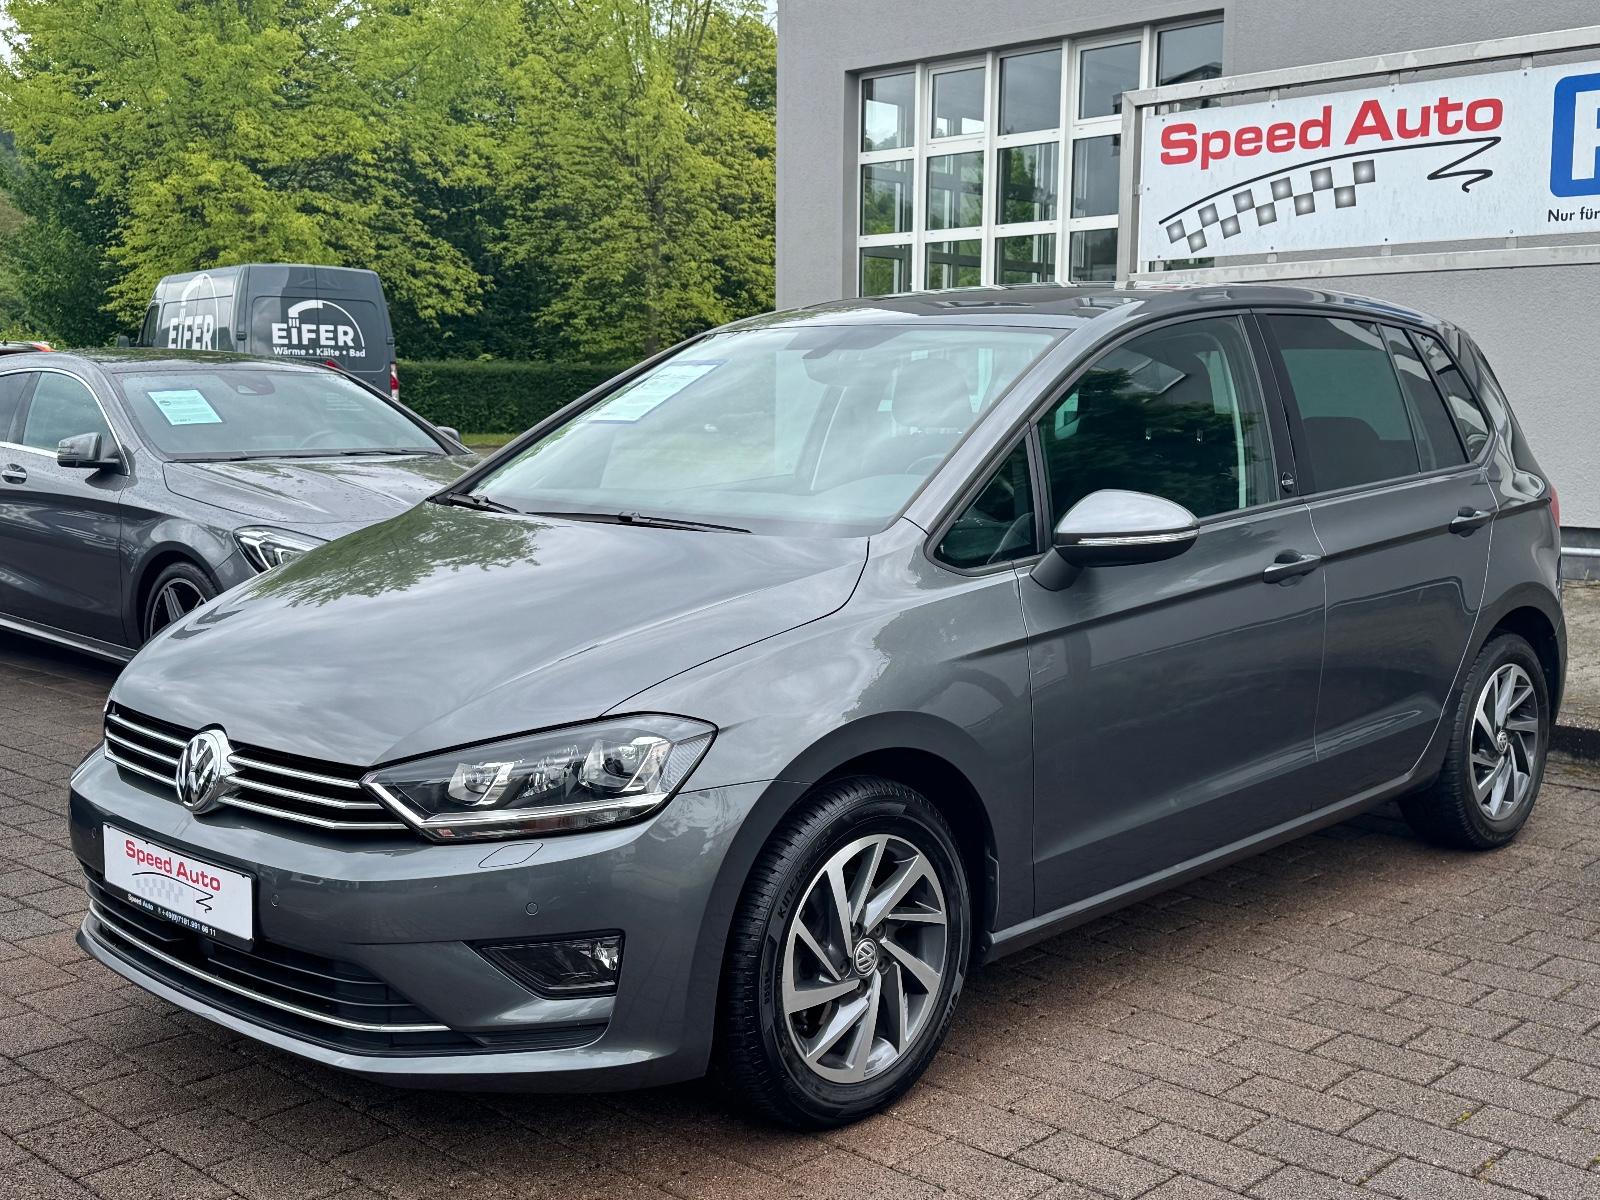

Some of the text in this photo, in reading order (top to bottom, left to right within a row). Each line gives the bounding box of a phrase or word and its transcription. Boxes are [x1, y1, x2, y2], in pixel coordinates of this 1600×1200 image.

[1159, 105, 1332, 171] Speed
[1344, 96, 1504, 146] Auto
[1547, 208, 1575, 223] Nur
[273, 346, 366, 358] Wärme Kälte Bad
[125, 839, 221, 892] Speed Auto
